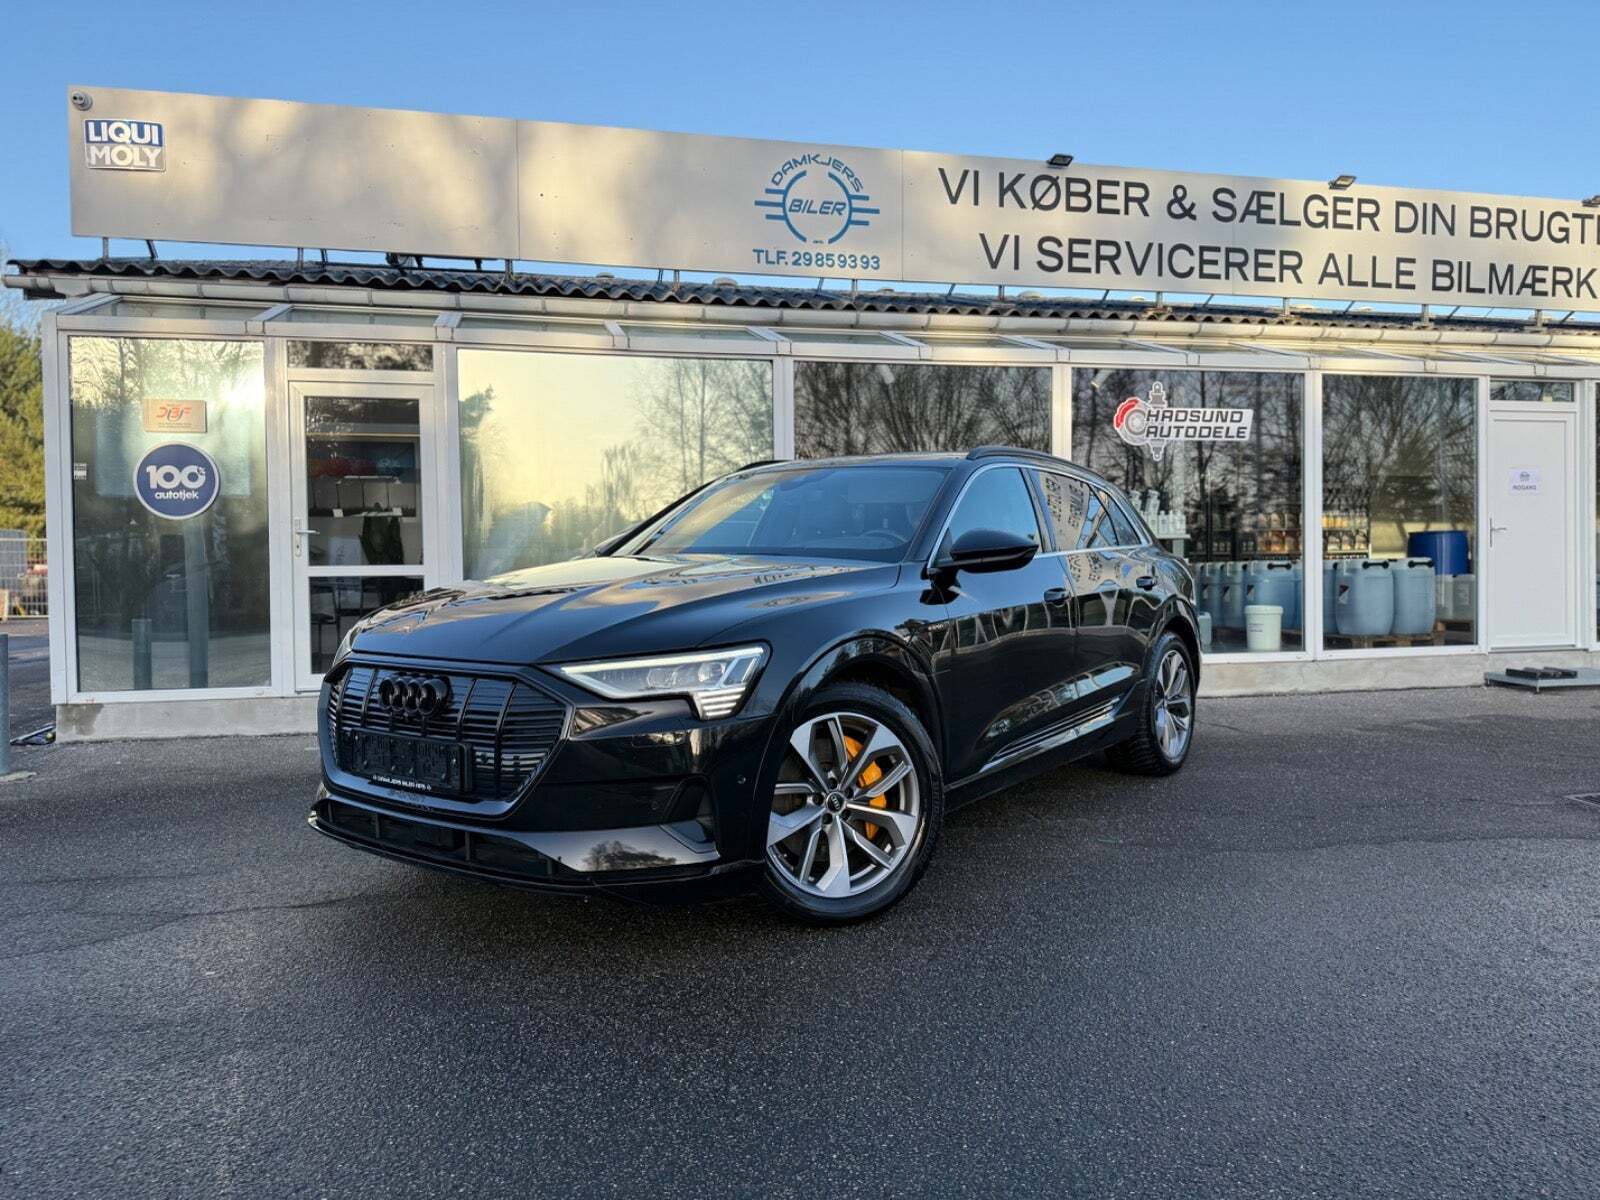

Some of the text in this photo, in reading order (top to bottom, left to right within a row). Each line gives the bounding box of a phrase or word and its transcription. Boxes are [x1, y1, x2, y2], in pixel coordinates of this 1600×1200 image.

[88, 121, 160, 145] LIQUI
[89, 144, 161, 167] MOLY
[771, 153, 864, 193] DAMKJERS
[788, 198, 847, 216] BILER
[938, 167, 1600, 246] VI KØBER & SÆLGER DIN BRUGT
[978, 232, 1598, 299] VI SERVICERER ALLE BILMÆRK
[1146, 409, 1244, 423] HADSUND
[1145, 425, 1248, 439] AUTODELE
[154, 489, 200, 501] autotjek
